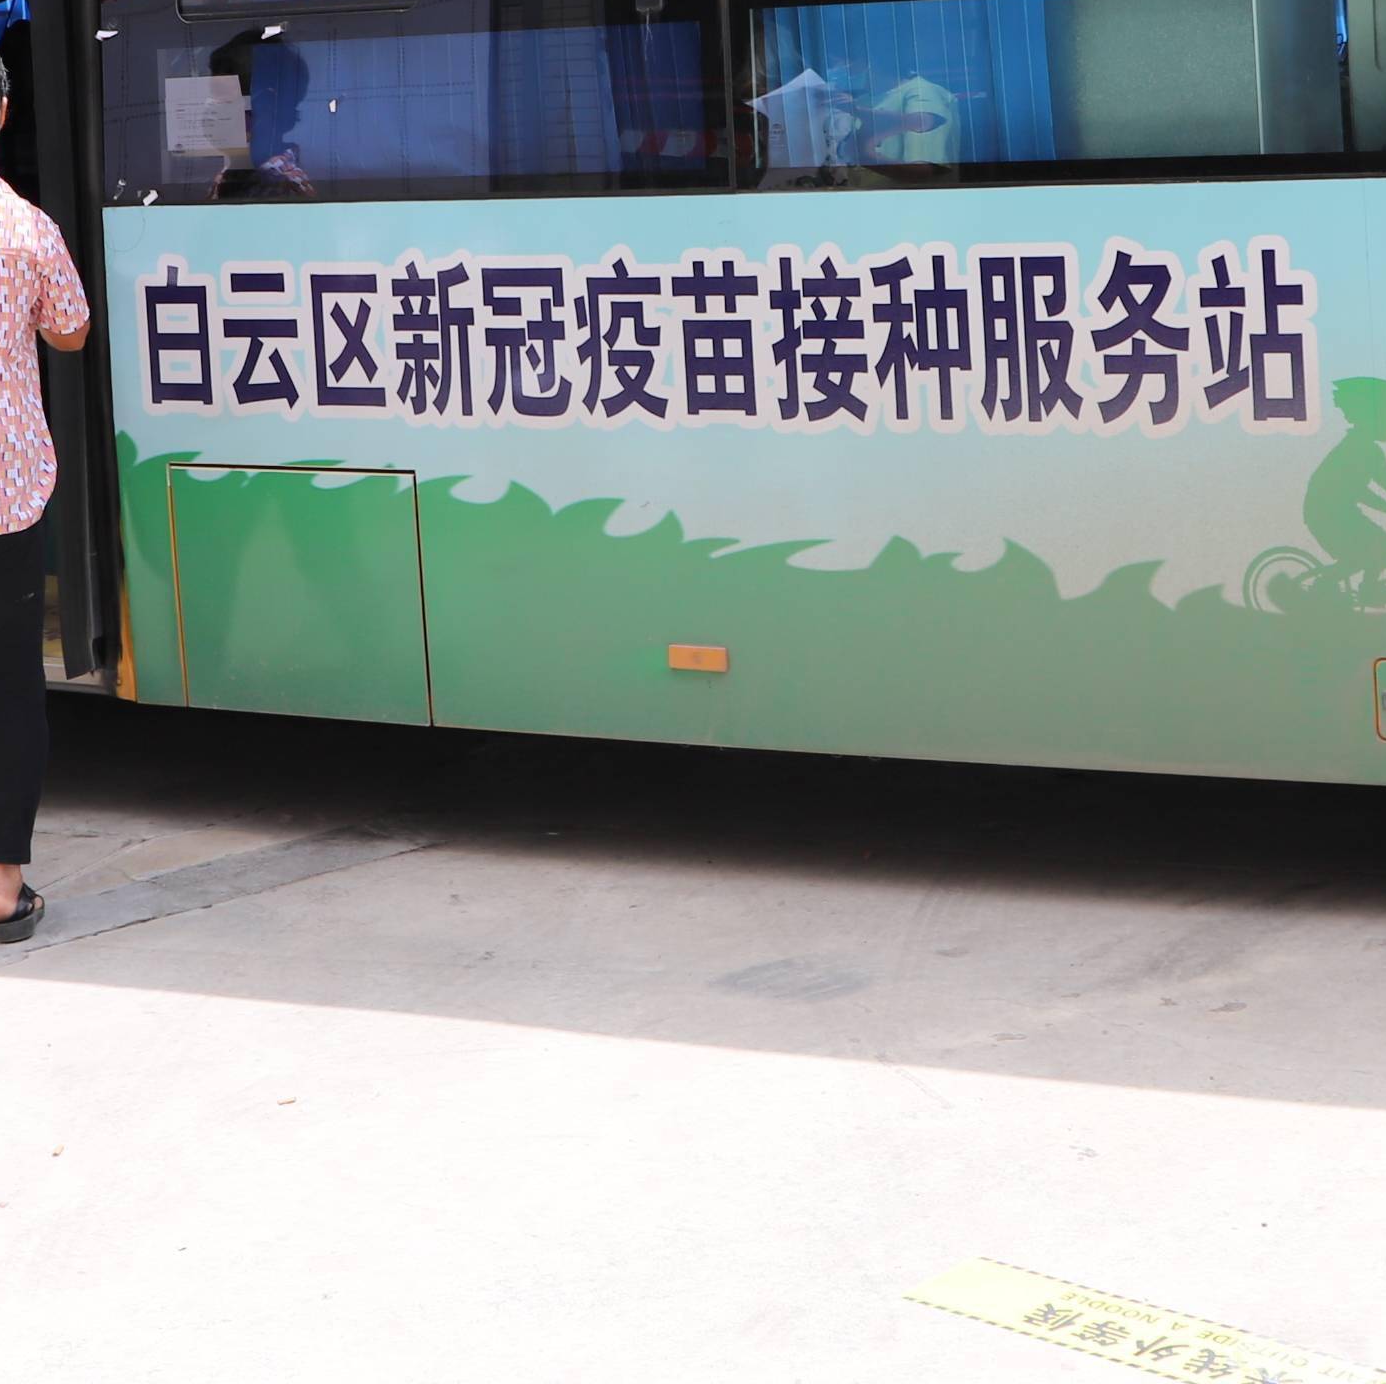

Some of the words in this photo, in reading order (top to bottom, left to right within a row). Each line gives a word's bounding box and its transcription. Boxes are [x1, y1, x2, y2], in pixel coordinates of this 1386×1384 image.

[144, 248, 1311, 424] 白云区新冠疫苗接种服务站
[1061, 1291, 1163, 1326] NOODLE
